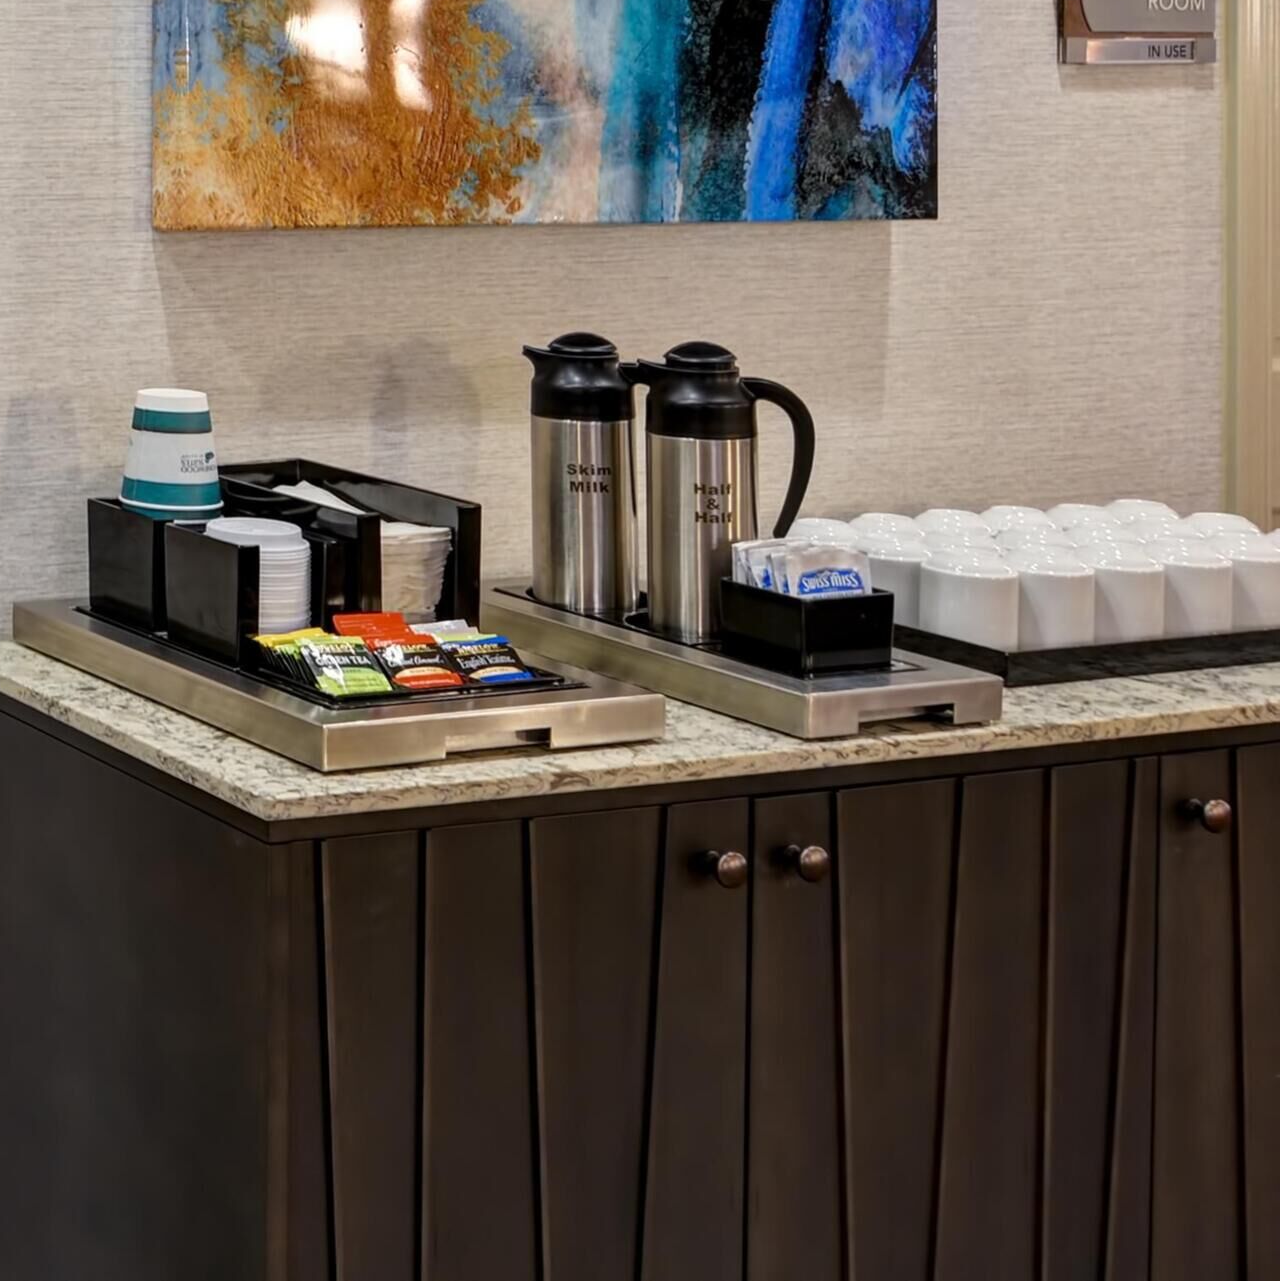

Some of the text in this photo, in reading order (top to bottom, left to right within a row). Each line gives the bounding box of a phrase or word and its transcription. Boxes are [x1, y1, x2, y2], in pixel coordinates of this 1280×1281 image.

[1148, 45, 1187, 58] IN USE
[567, 463, 611, 476] Skim
[569, 481, 611, 493] Milk
[694, 483, 732, 496] Half
[706, 498, 720, 511] &
[695, 511, 733, 524] Half
